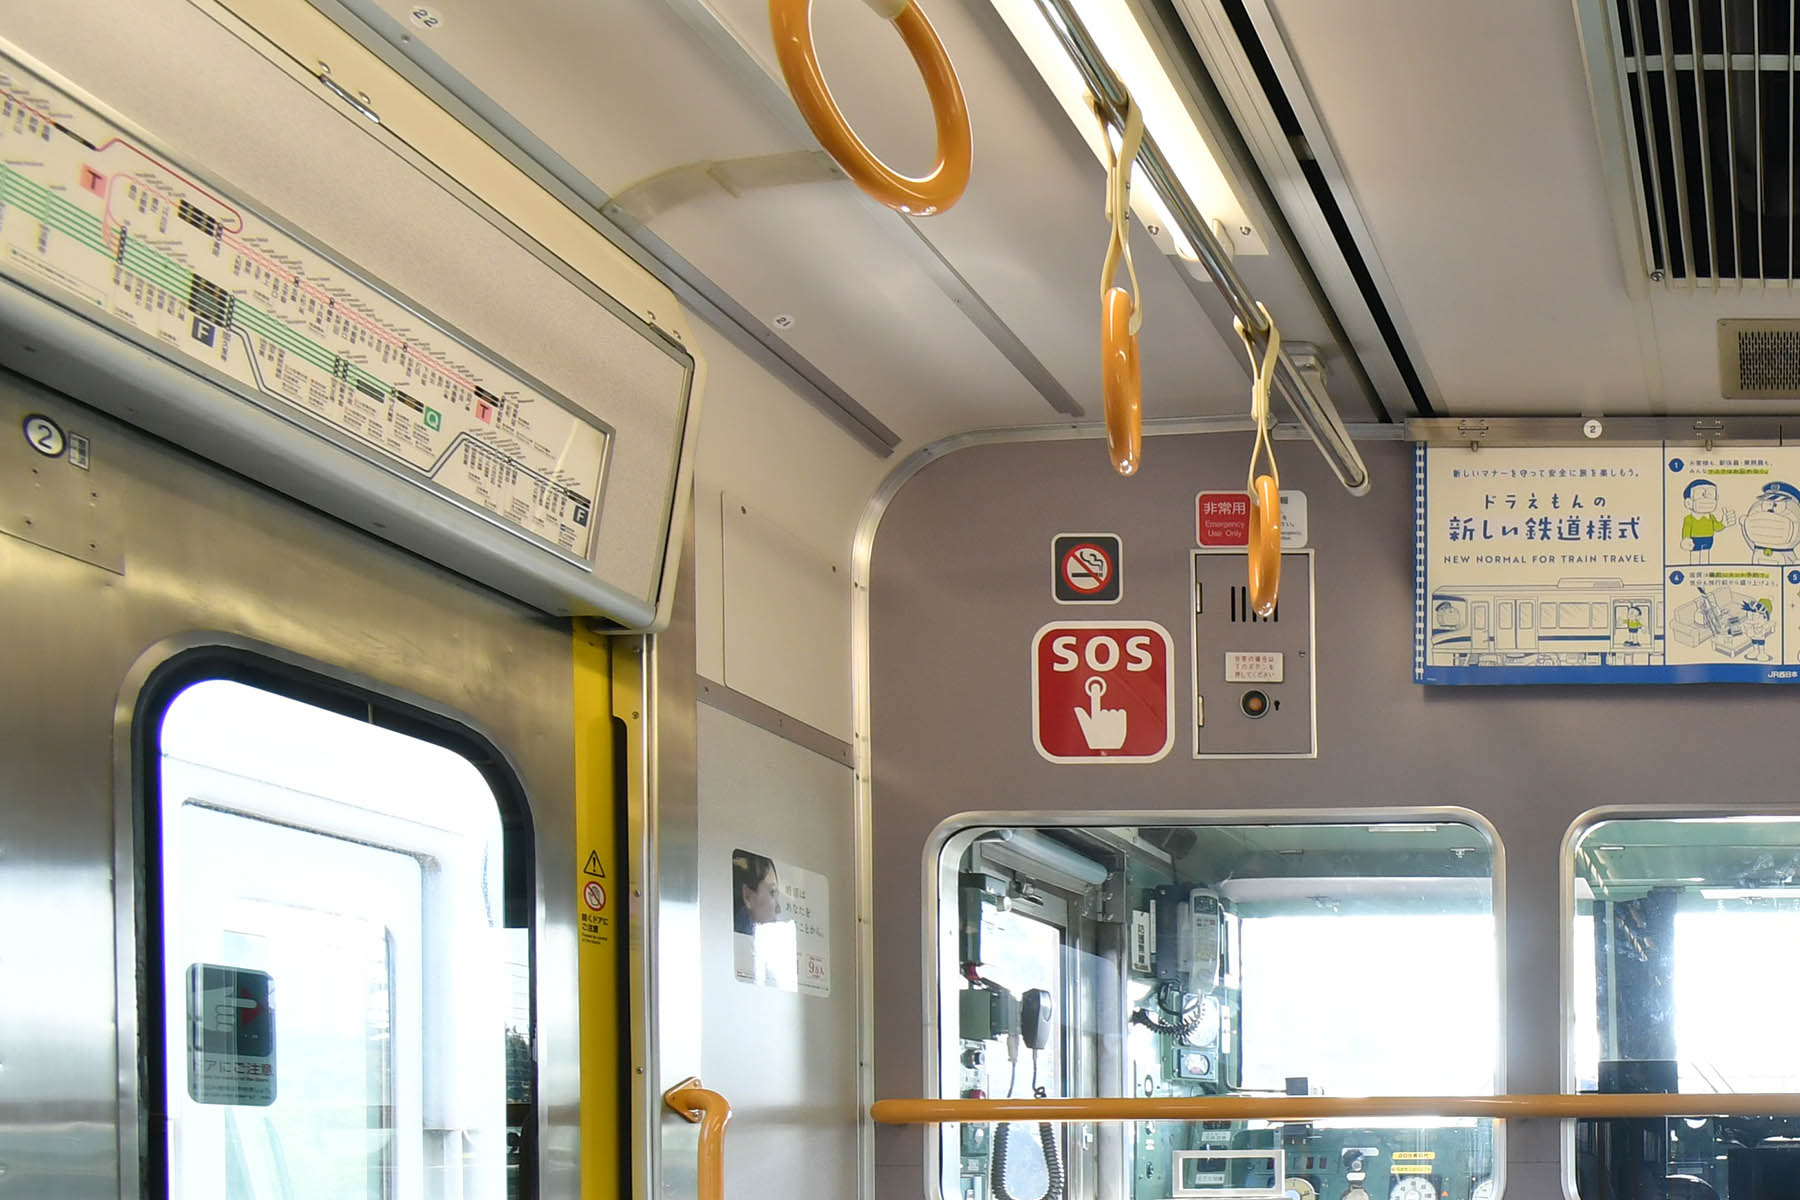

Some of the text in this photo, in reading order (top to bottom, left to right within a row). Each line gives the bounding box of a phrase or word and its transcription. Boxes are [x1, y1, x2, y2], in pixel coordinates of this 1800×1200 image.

[412, 8, 439, 28] 22
[1203, 501, 1247, 515] 非常用
[1485, 492, 1606, 510] ドラえもんの
[1204, 519, 1245, 529] Emergency
[1449, 514, 1641, 542] 新しい鉄道様式
[1207, 529, 1242, 538] Use Only
[1443, 554, 1647, 564] NEW NORMAL FOR TRAIN TRAVEL
[1051, 634, 1154, 673] SOS
